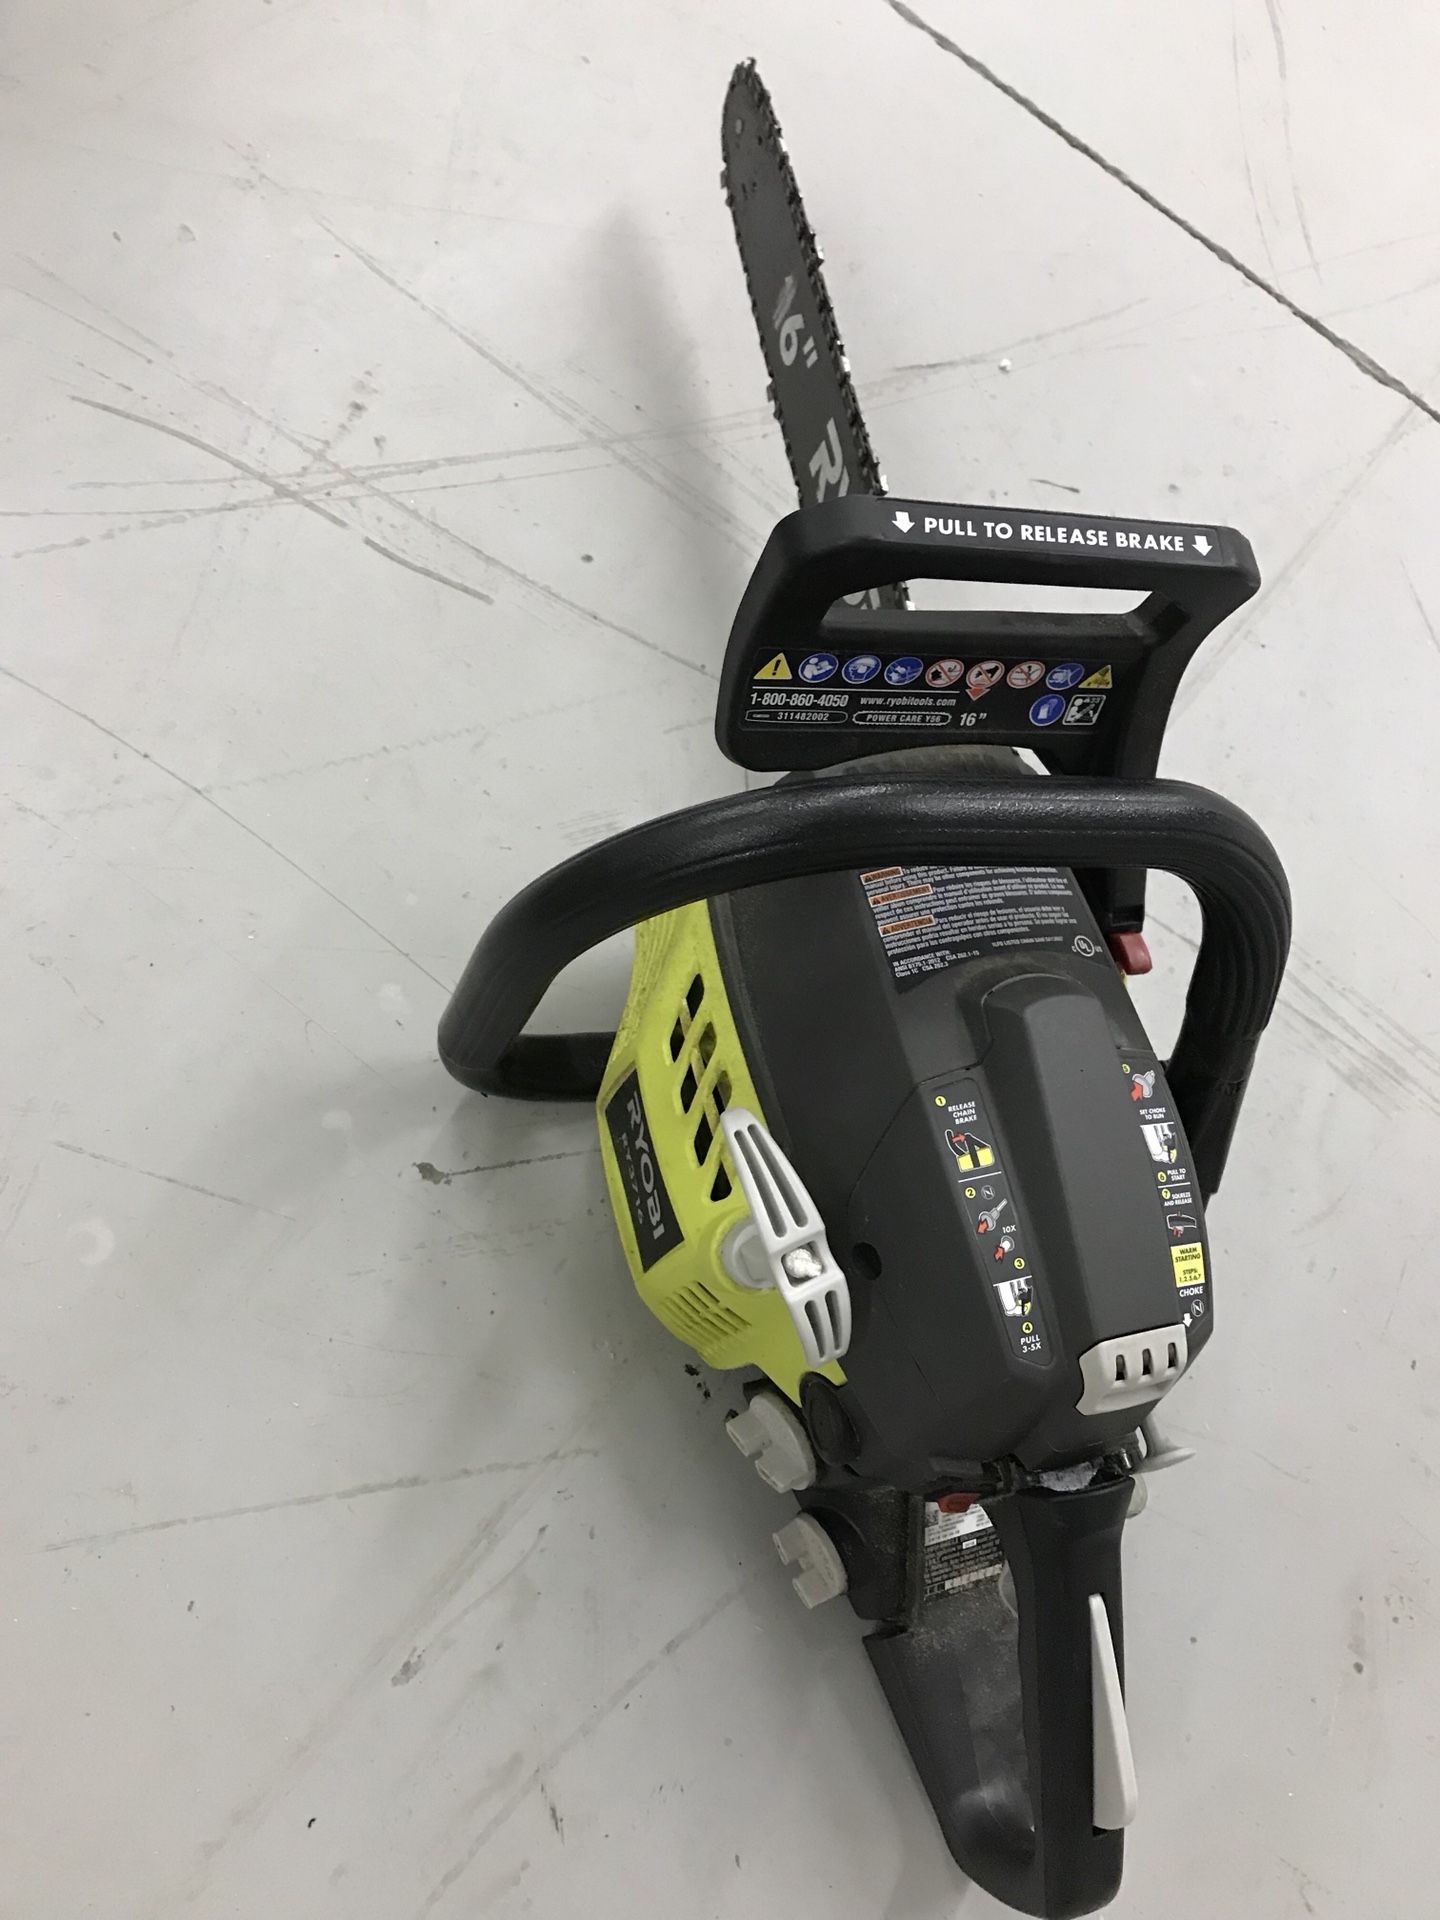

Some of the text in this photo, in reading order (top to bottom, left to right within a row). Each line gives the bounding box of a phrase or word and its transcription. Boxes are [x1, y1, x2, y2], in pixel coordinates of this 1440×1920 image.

[924, 517, 1185, 551] PULL TO RELEASE BRAKE
[750, 692, 849, 706] 1-800-860-4050
[860, 696, 956, 707] www.ryobitools.com
[777, 712, 830, 720] 311482002
[866, 714, 941, 723] POWER CARE Y56
[900, 953, 934, 966] ACCORDANCE
[894, 964, 908, 972] ANSI
[948, 1101, 976, 1112] RELEASE
[952, 1108, 976, 1118] CHAIN
[955, 1114, 977, 1124] BRAKE
[626, 1091, 665, 1240] RYOBI
[1002, 1225, 1016, 1234] 10X
[1180, 1247, 1197, 1255] WARM
[1175, 1253, 1201, 1263] STARTING
[1180, 1286, 1203, 1298] CHOKE
[1020, 1334, 1040, 1345] PULL
[1022, 1342, 1042, 1353] 3-5X
